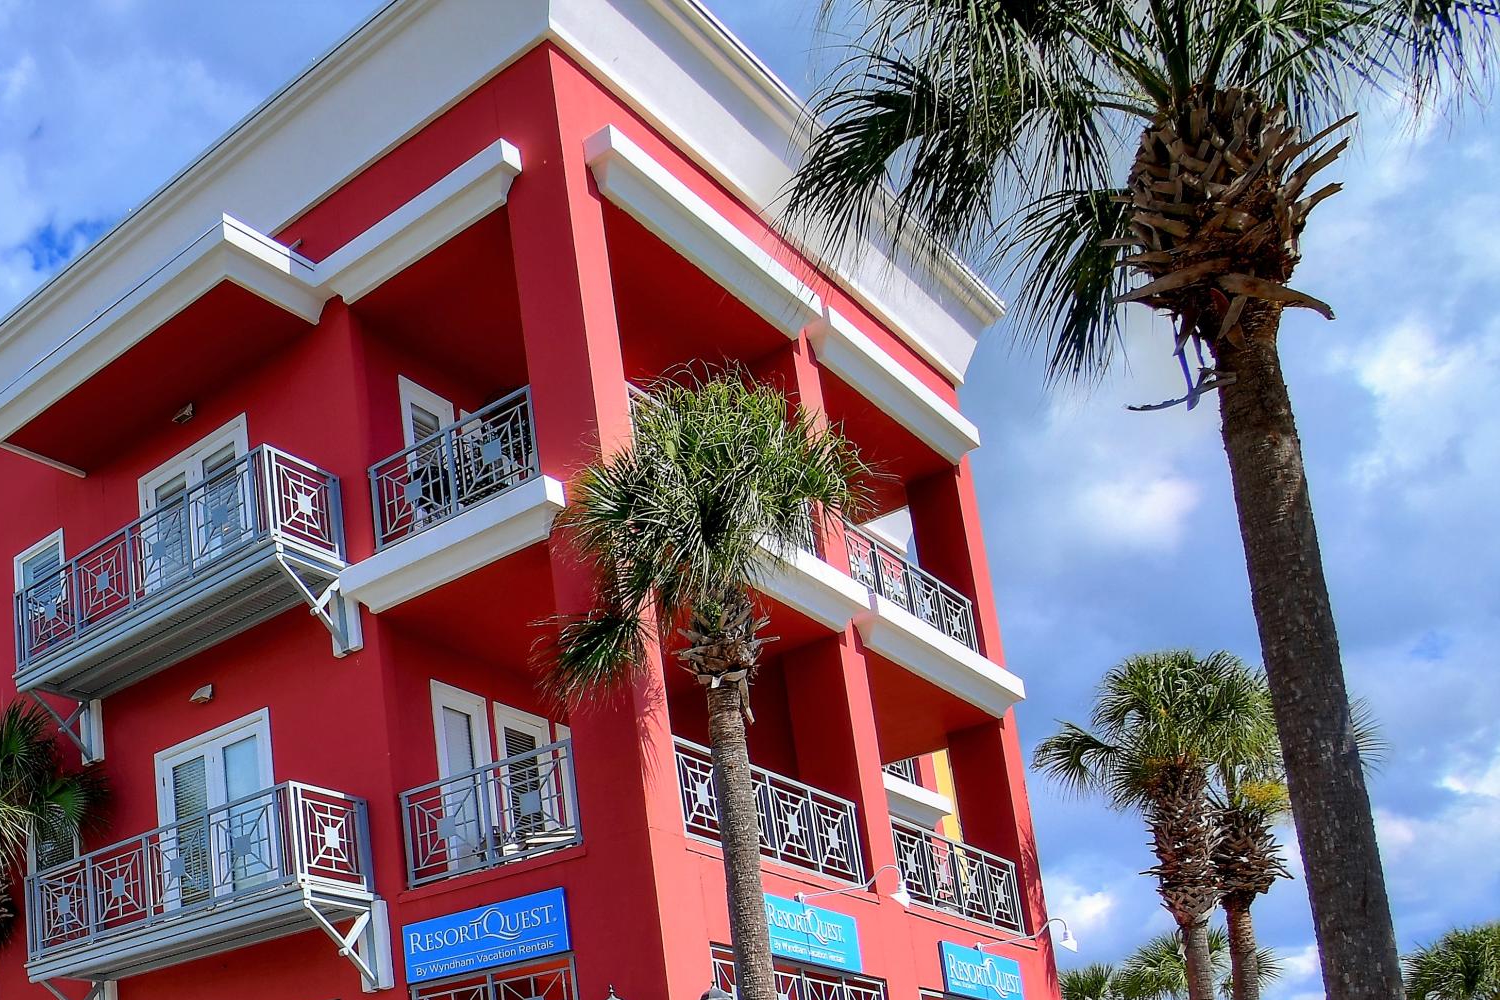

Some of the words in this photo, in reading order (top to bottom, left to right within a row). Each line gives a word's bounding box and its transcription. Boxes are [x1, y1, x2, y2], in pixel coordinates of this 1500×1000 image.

[416, 966, 428, 977] By
[430, 956, 475, 973] Wyndham
[476, 948, 517, 964] Vacation
[518, 940, 554, 954] Rentals
